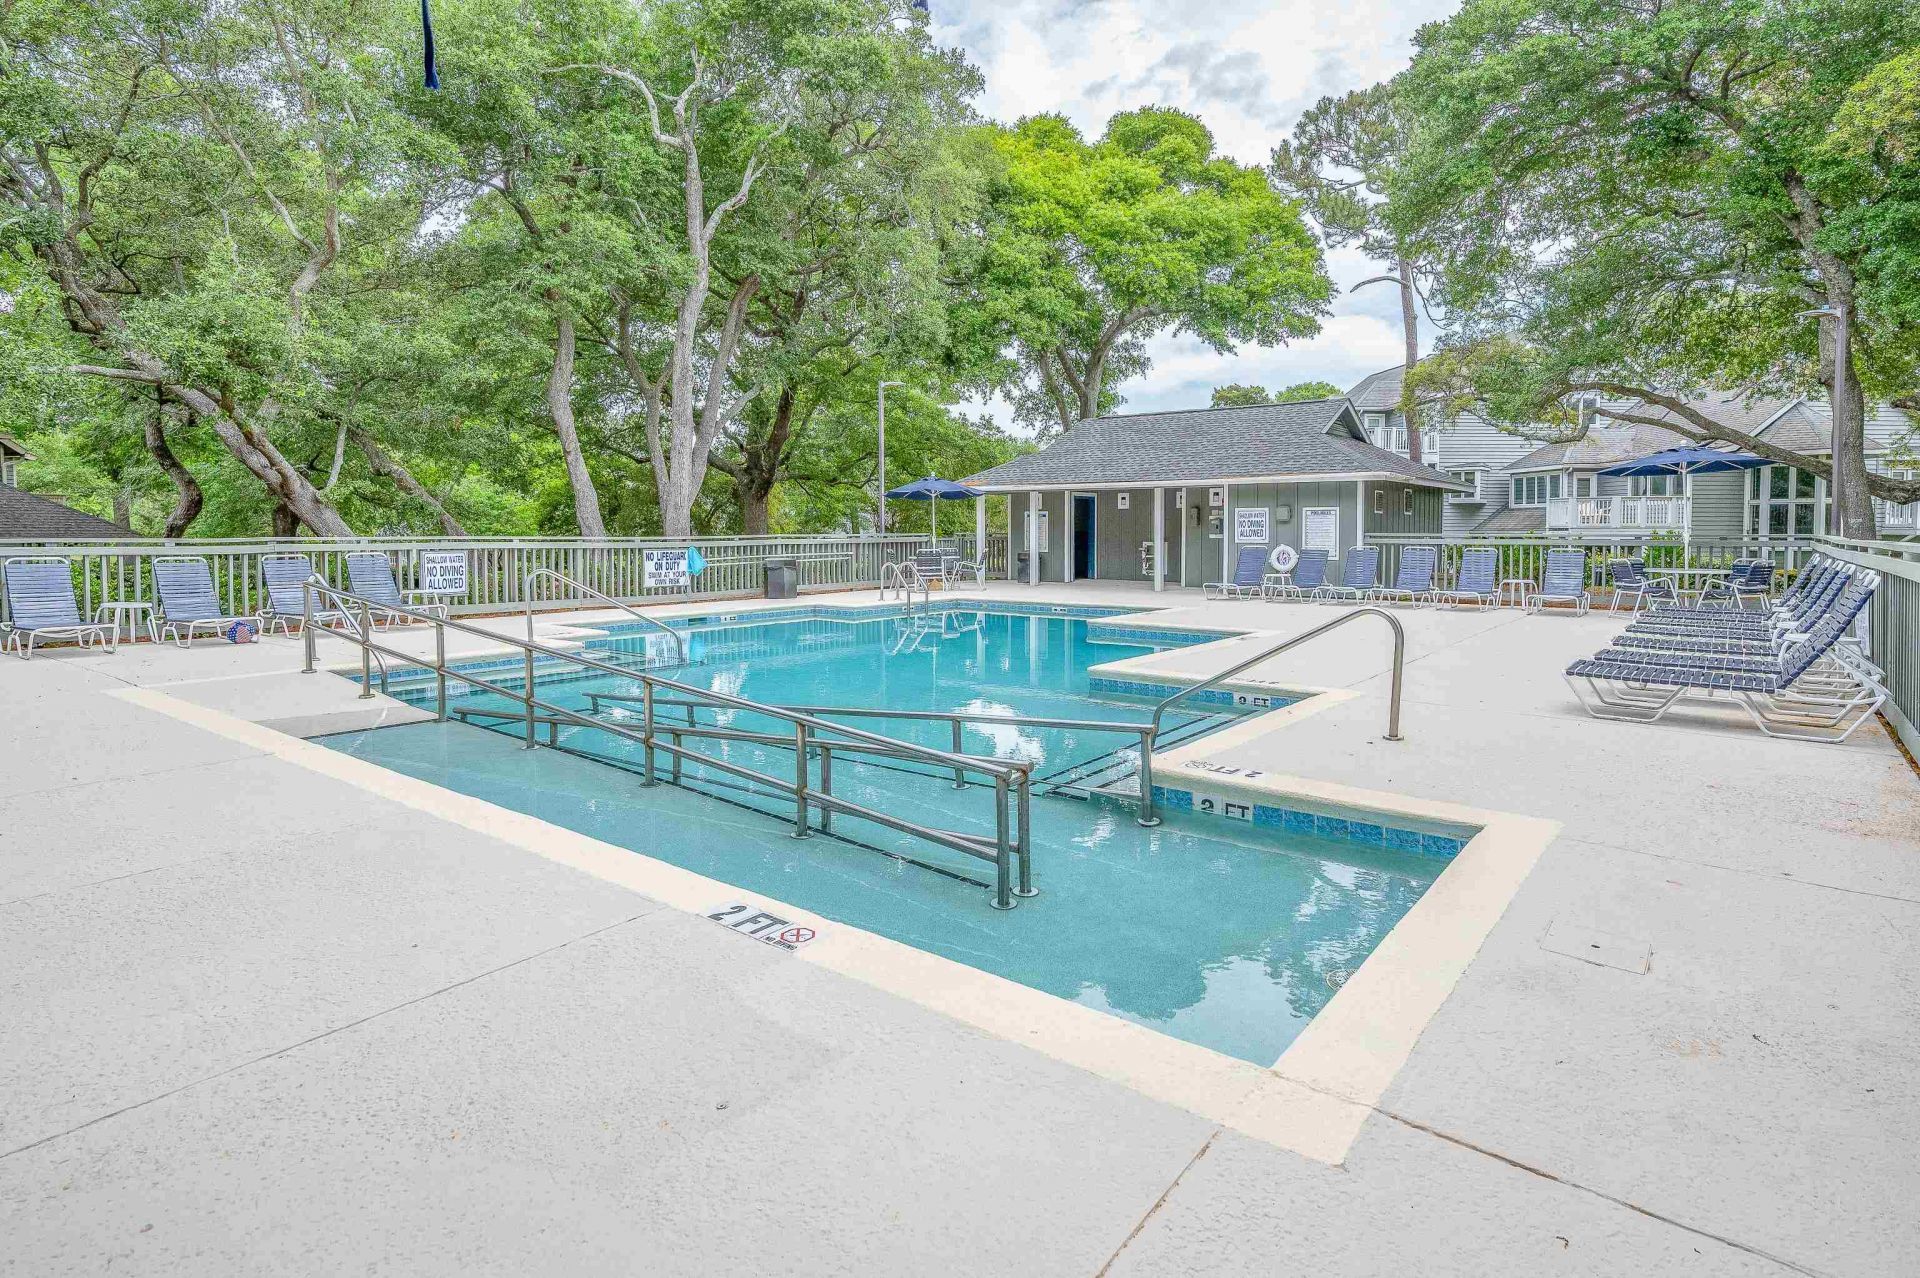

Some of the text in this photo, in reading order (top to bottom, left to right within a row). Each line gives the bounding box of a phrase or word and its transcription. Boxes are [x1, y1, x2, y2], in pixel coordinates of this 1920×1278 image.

[1239, 519, 1264, 528] NO DIVING
[1240, 529, 1263, 537] ALLOWED
[426, 555, 464, 564] SHALLOW WATER
[645, 552, 654, 561] NO
[426, 565, 464, 577] NO DIVING
[654, 561, 680, 571] ON DUTY
[428, 578, 464, 590] ALLOWED
[1201, 799, 1249, 818] 2 FT
[707, 905, 790, 934] 2 FT
